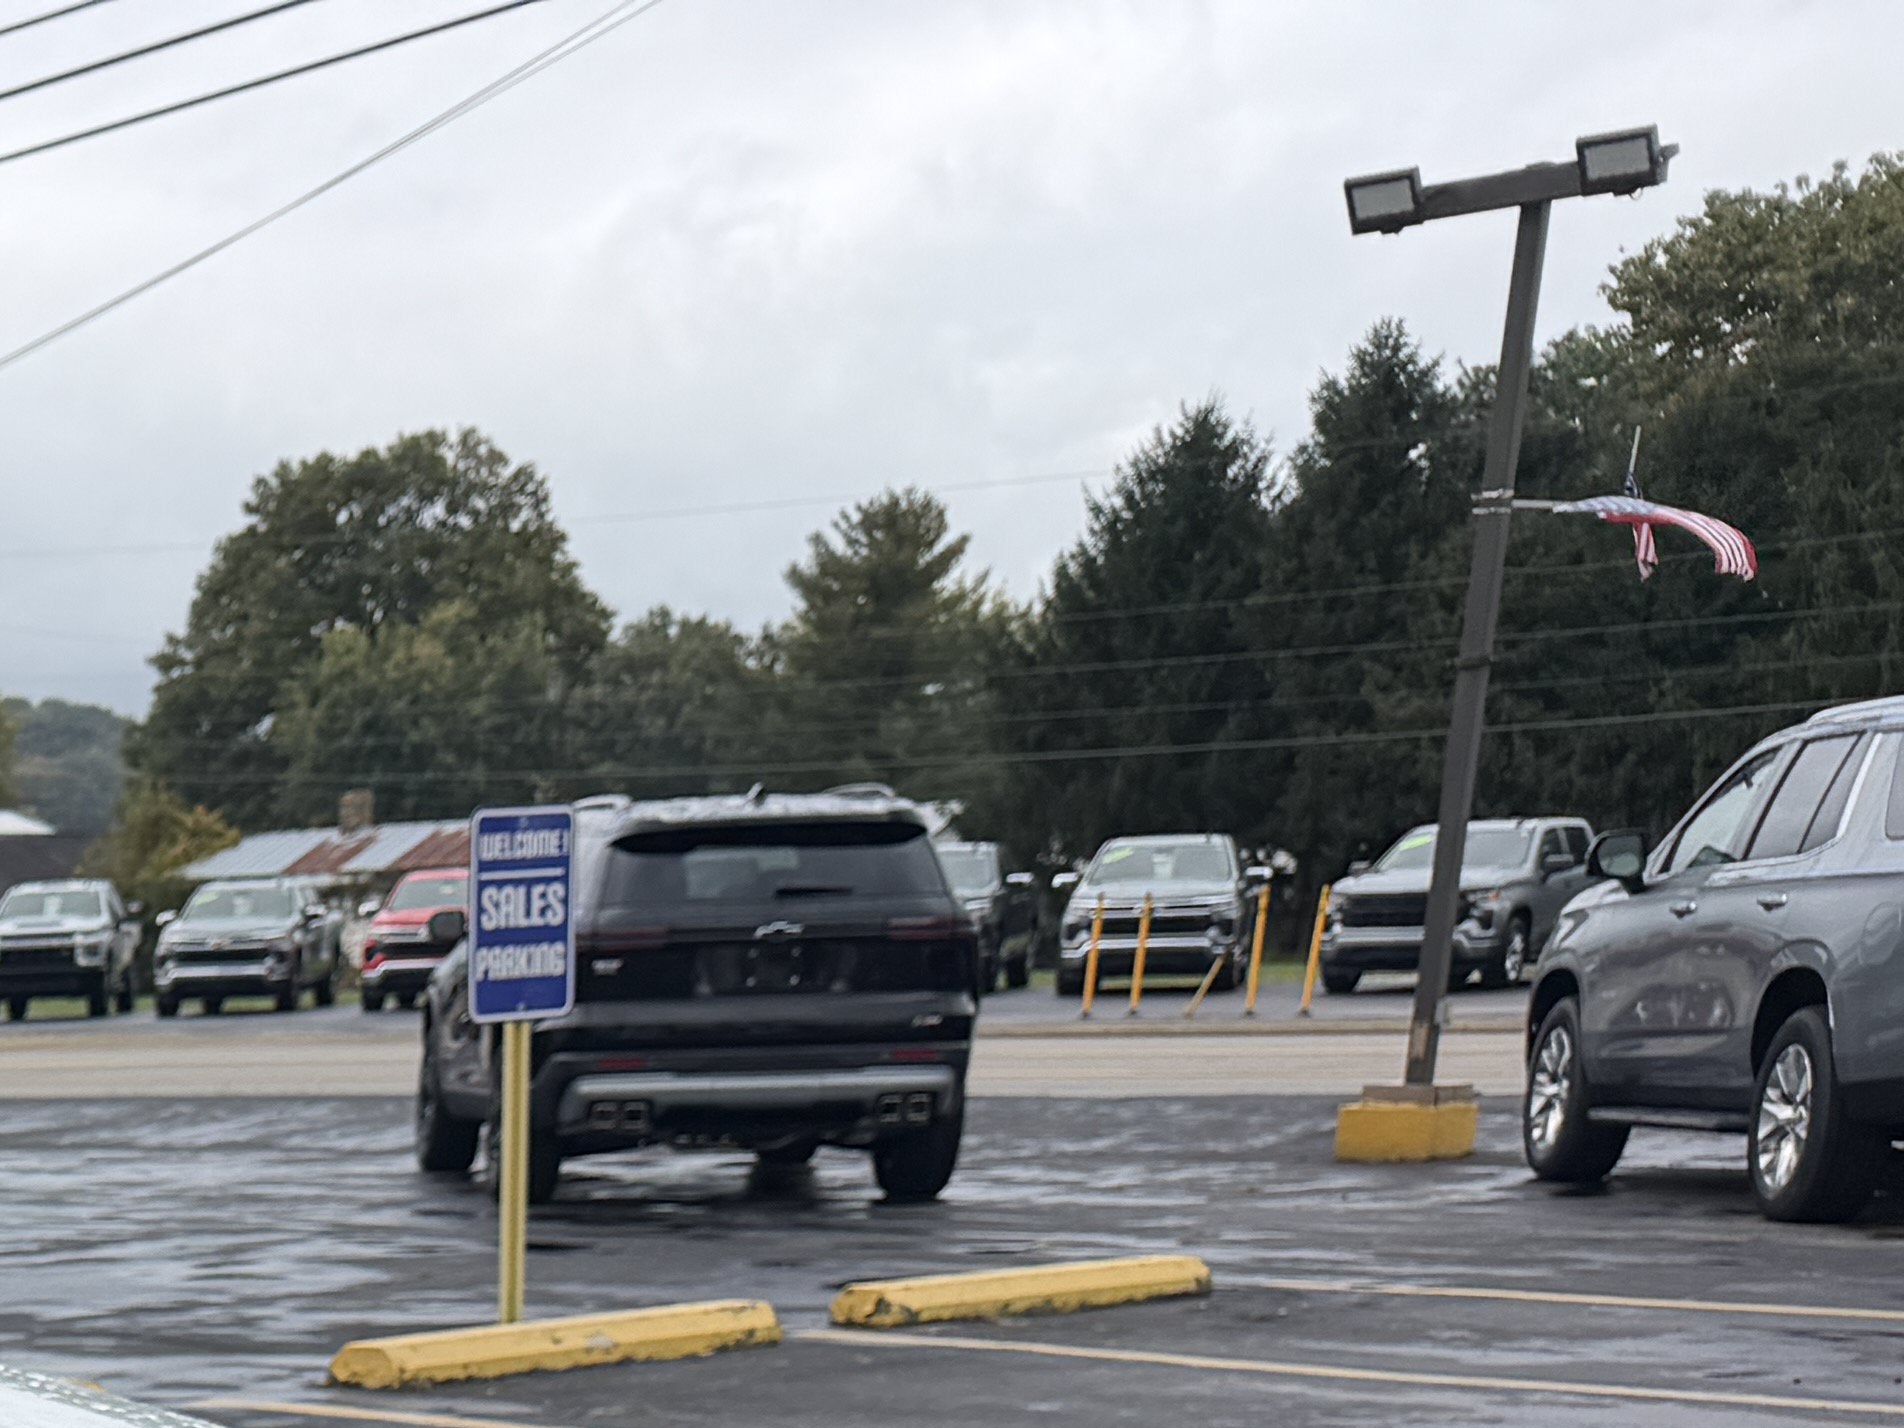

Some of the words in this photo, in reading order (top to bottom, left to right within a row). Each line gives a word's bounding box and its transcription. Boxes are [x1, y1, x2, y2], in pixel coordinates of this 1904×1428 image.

[479, 829, 570, 861] WELCOME!
[480, 881, 567, 931] SALES
[476, 941, 566, 982] PARKING
